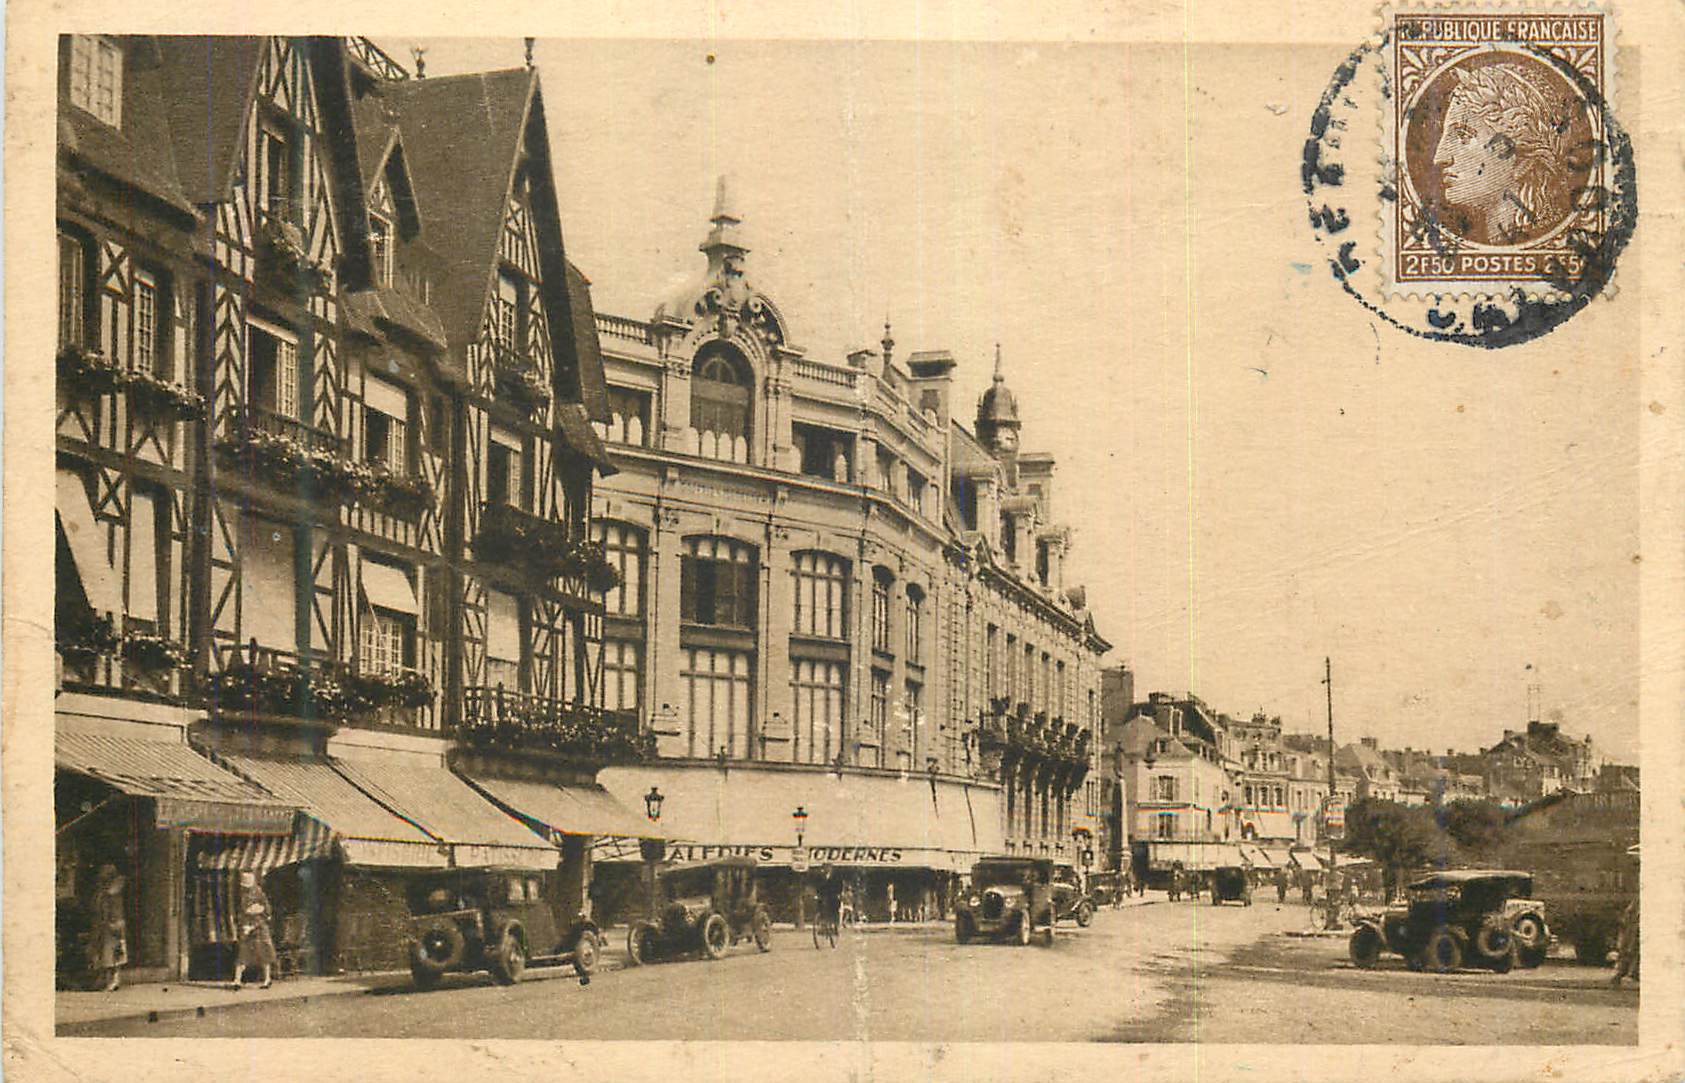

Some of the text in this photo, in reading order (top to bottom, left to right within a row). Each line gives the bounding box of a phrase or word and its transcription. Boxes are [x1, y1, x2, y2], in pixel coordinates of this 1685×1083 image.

[1401, 20, 1500, 41] RPUBLIQUE
[1405, 254, 1455, 274] 2F50
[1461, 255, 1537, 274] POSTES
